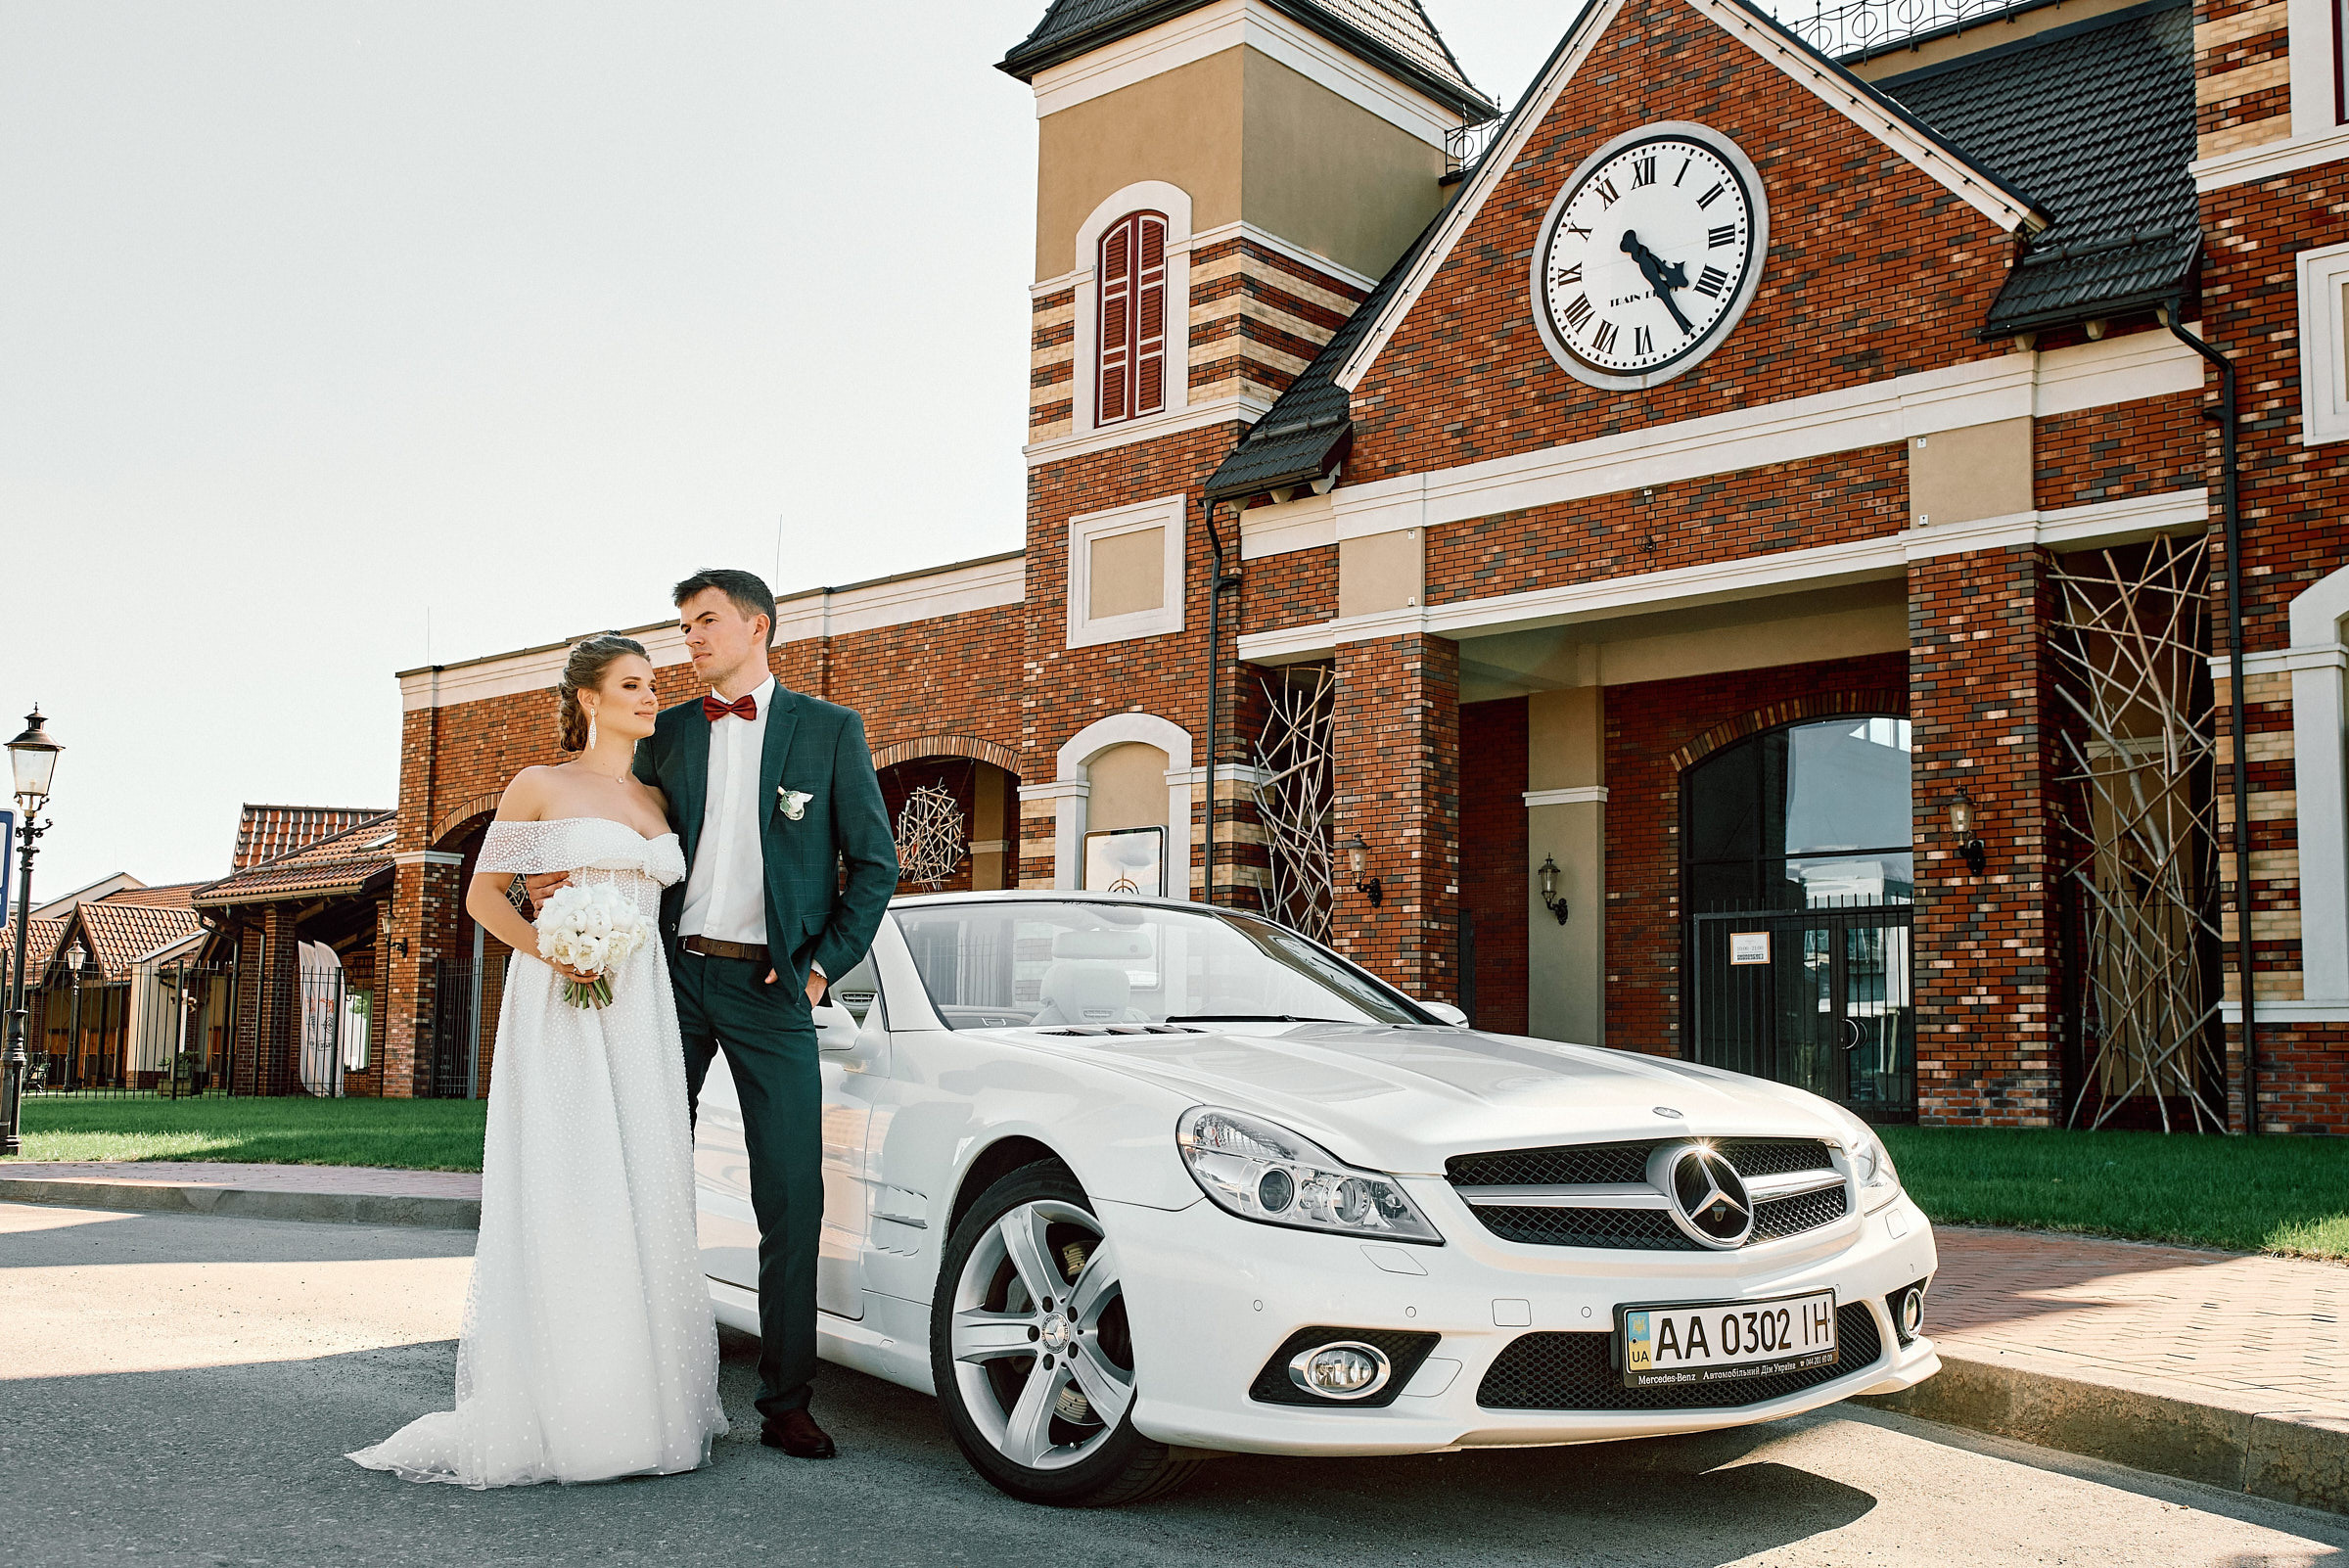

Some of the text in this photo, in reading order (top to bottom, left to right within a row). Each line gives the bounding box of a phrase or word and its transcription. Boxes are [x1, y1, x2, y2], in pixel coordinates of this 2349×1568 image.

[1631, 156, 1657, 190] XII
[1673, 159, 1691, 187] I
[1592, 176, 1621, 211] XI
[1696, 181, 1726, 210] II
[1567, 220, 1593, 242] X
[1708, 223, 1735, 250] III
[1558, 261, 1583, 288] IX
[1693, 263, 1728, 299] IIII
[1563, 291, 1595, 335] VIII
[1610, 293, 1641, 307] TRAIN
[1591, 319, 1620, 355] VII
[1635, 325, 1655, 356] VI
[1655, 1301, 1829, 1361] AA 0302 IH
[1632, 1351, 1650, 1362] UA
[1637, 1372, 1696, 1385] Mercedes-Benz
